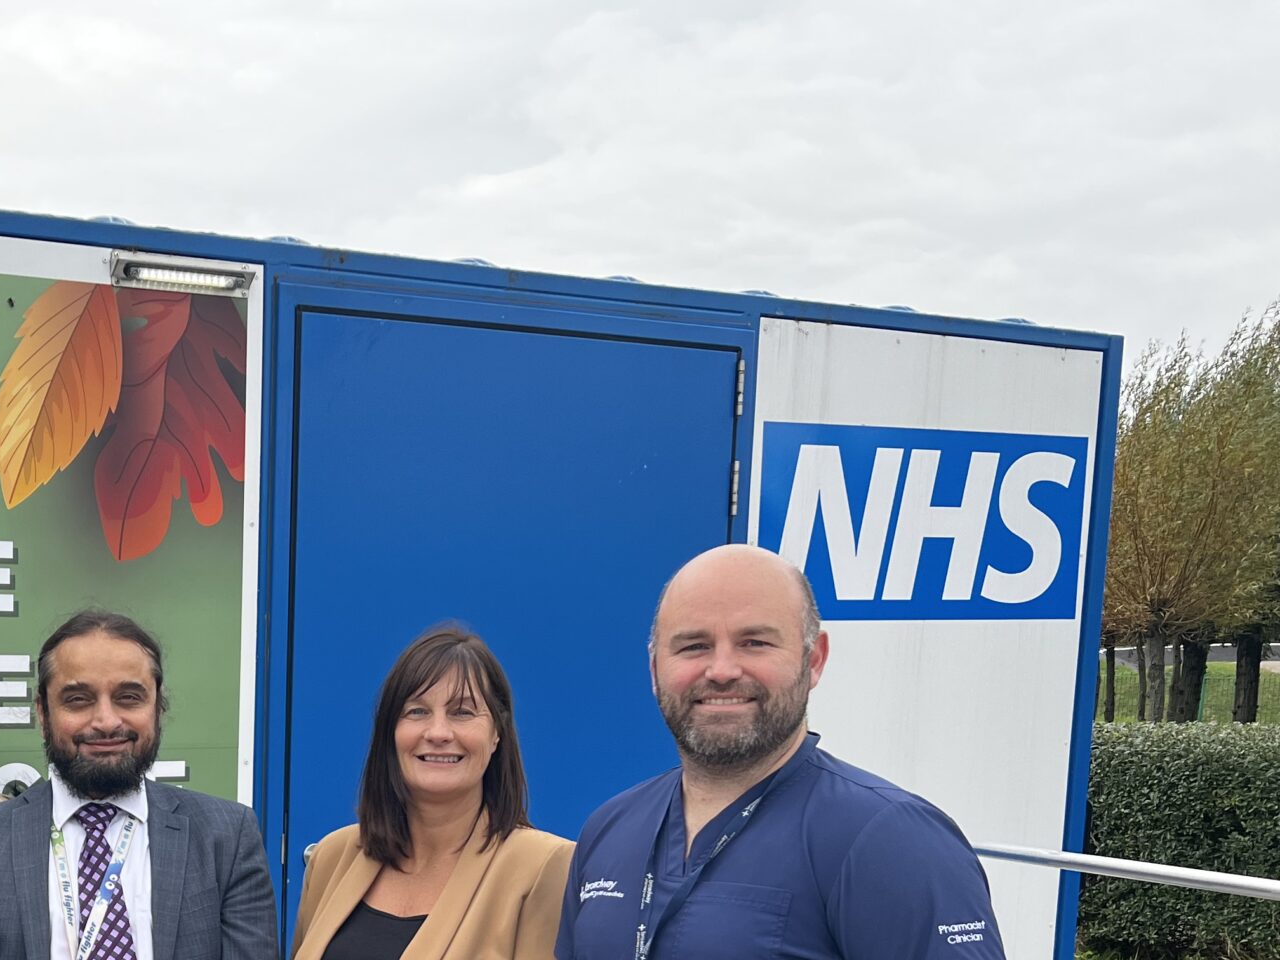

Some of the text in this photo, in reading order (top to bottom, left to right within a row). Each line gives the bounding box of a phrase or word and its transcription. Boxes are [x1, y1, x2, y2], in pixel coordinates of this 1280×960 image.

[779, 444, 1076, 604] NHS
[63, 895, 74, 926] fighter
[80, 922, 97, 954] fighter
[938, 920, 986, 935] Pharmacist
[947, 933, 984, 945] Clinician
